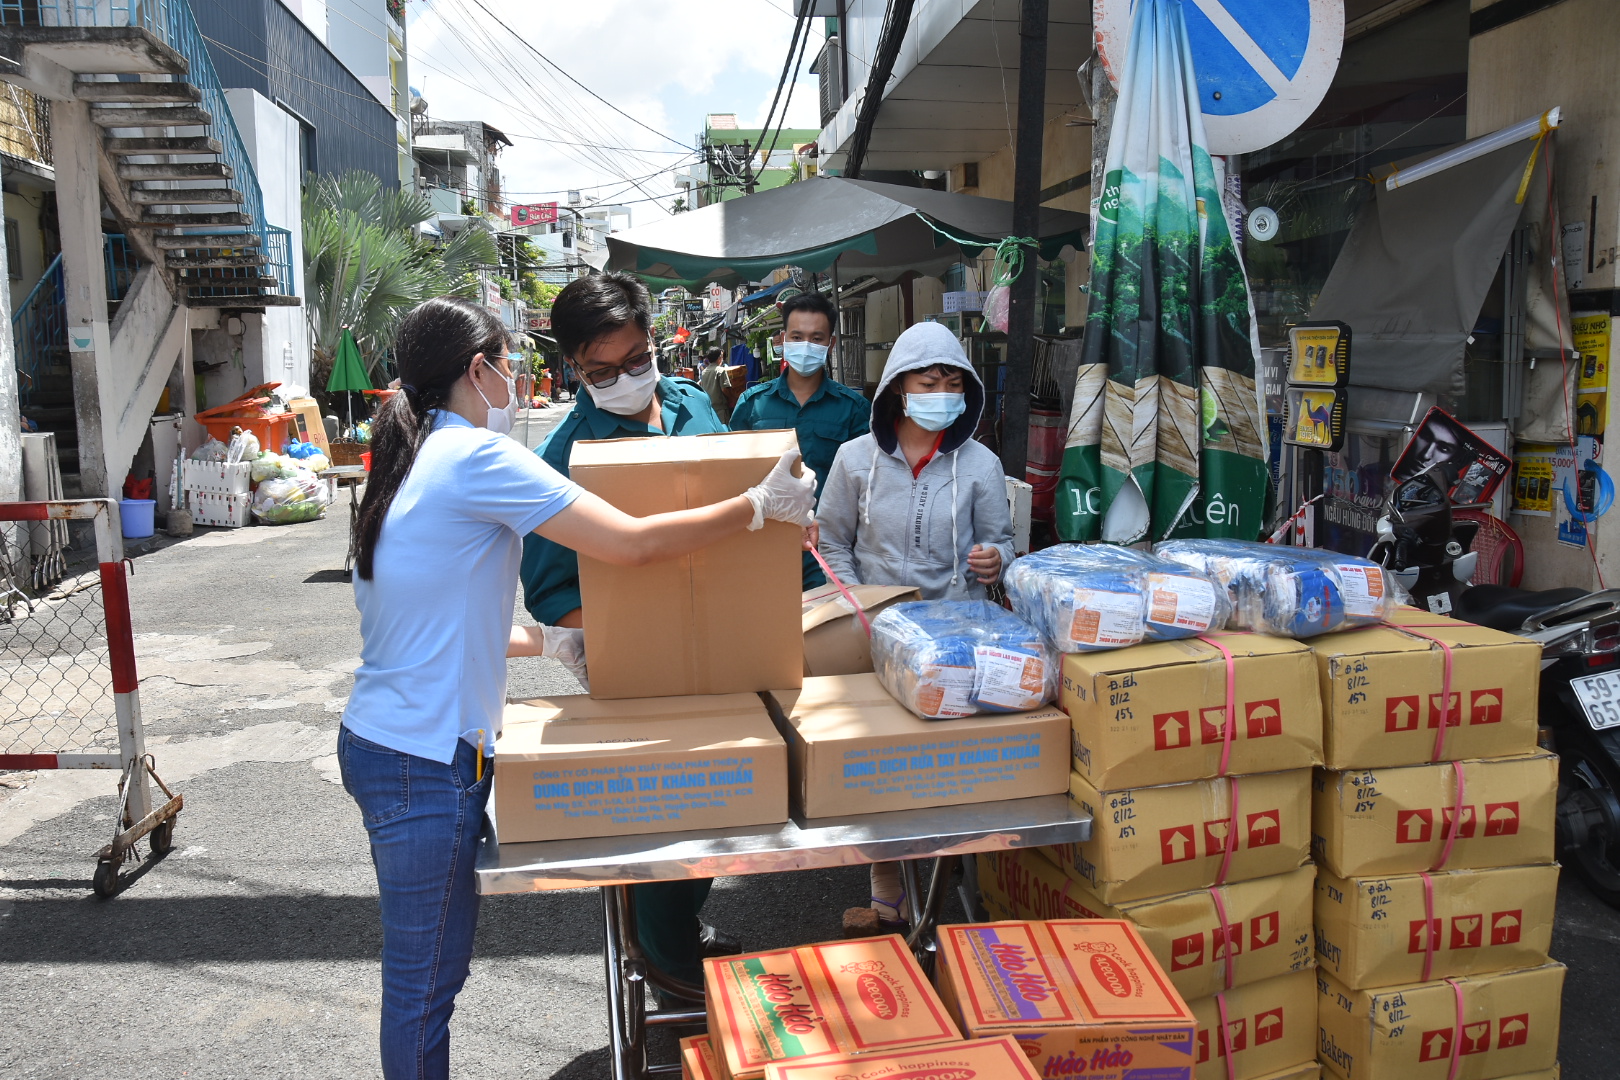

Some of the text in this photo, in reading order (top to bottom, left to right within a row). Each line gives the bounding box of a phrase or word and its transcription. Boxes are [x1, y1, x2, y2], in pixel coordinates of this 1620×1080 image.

[1106, 184, 1121, 197] th
[1070, 487, 1101, 516] 10
[533, 770, 561, 779] CÔNG
[563, 769, 574, 777] TY
[741, 757, 753, 765] AN
[843, 738, 1041, 778] DUNG DỊCH RỬA TAY KHÁNG KHUẨN
[533, 763, 753, 799] DUNG DỊCH RỬA TAY KHÁNG KHUẨN
[1327, 885, 1343, 904] TM
[989, 942, 1036, 973] Hảo
[754, 972, 803, 1003] Hảo
[879, 970, 912, 1018] Cook happiness
[1009, 971, 1058, 1003] Hảo
[1337, 992, 1353, 1013] TM
[775, 1002, 826, 1036] Hảo
[1079, 1032, 1185, 1044] SẢN PHẨM VỚI CÔNG NGHỆ NHẬT BẢN
[1320, 1027, 1353, 1079] Bakery
[861, 1060, 971, 1079] Cook happiness
[1043, 1043, 1133, 1077] Hảo Hảo
